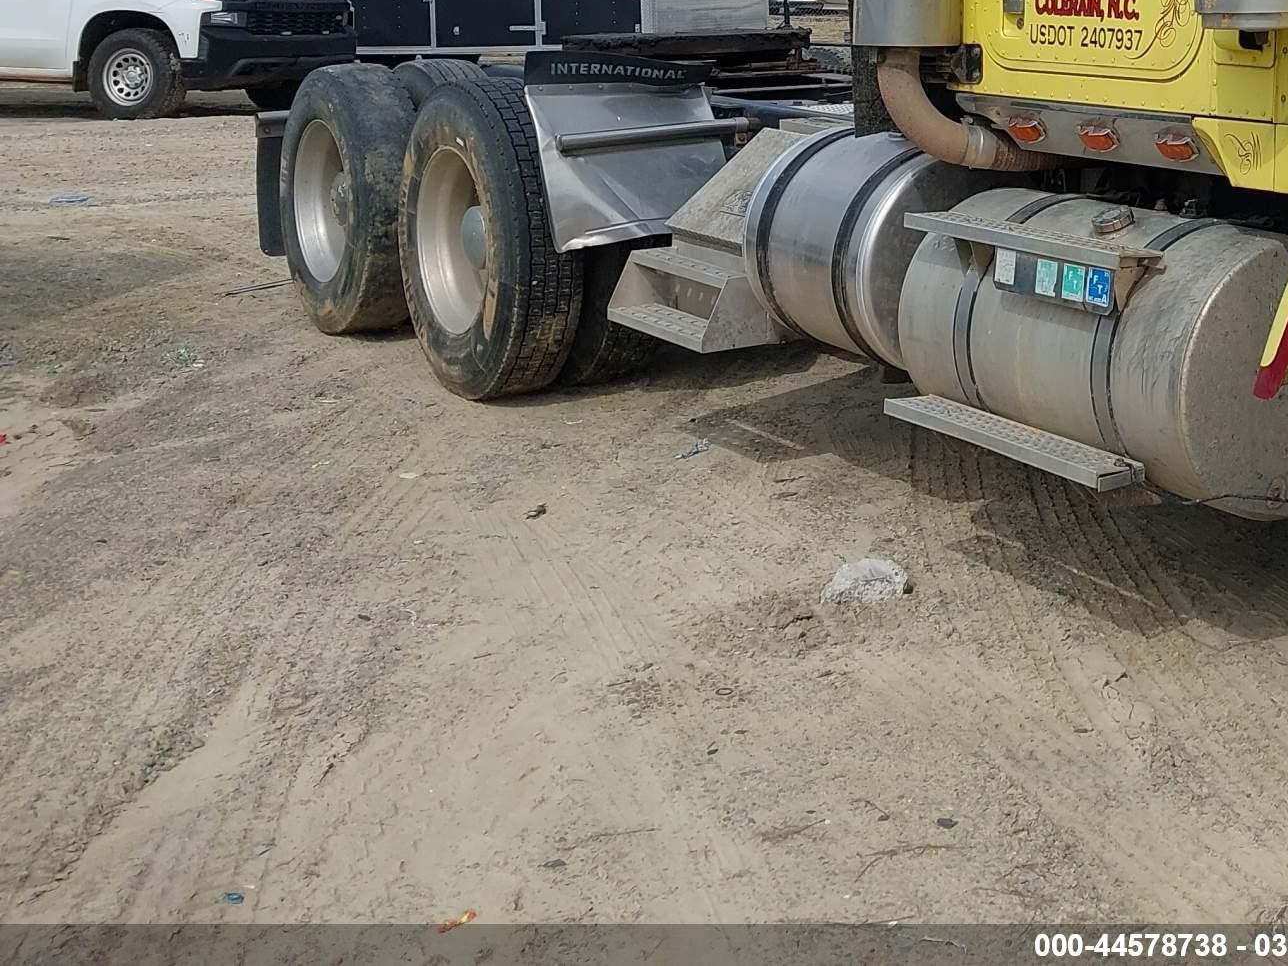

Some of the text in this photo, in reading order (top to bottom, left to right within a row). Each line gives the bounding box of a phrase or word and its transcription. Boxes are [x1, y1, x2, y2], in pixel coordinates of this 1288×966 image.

[1030, 23, 1143, 51] USDOT 2407937
[551, 62, 686, 79] INTERNATIONAL
